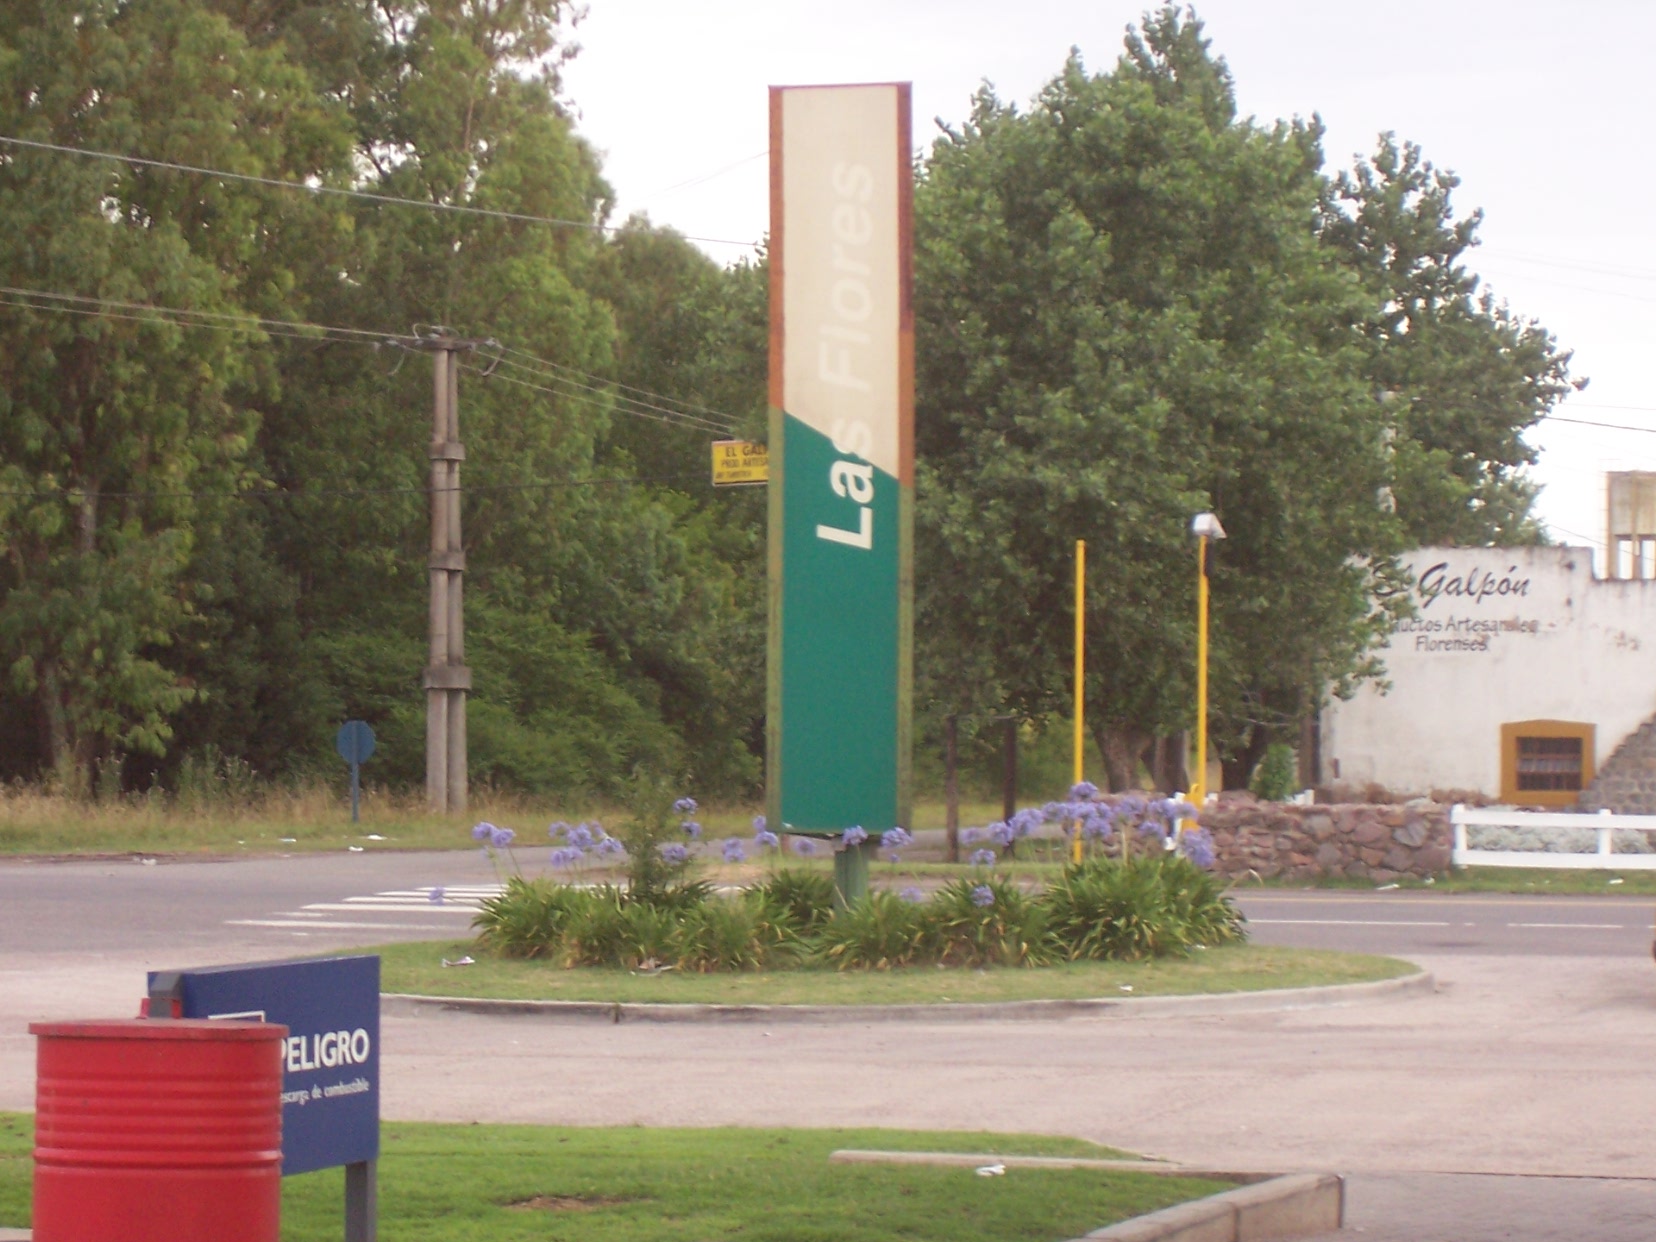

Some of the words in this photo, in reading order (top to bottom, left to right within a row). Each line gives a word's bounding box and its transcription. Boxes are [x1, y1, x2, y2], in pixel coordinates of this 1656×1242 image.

[818, 160, 873, 392] Flores
[816, 417, 873, 550] Las
[1418, 562, 1530, 609] Galpón
[1415, 634, 1488, 651] Florenses
[311, 1084, 322, 1099] de
[324, 1077, 369, 1097] combustible
